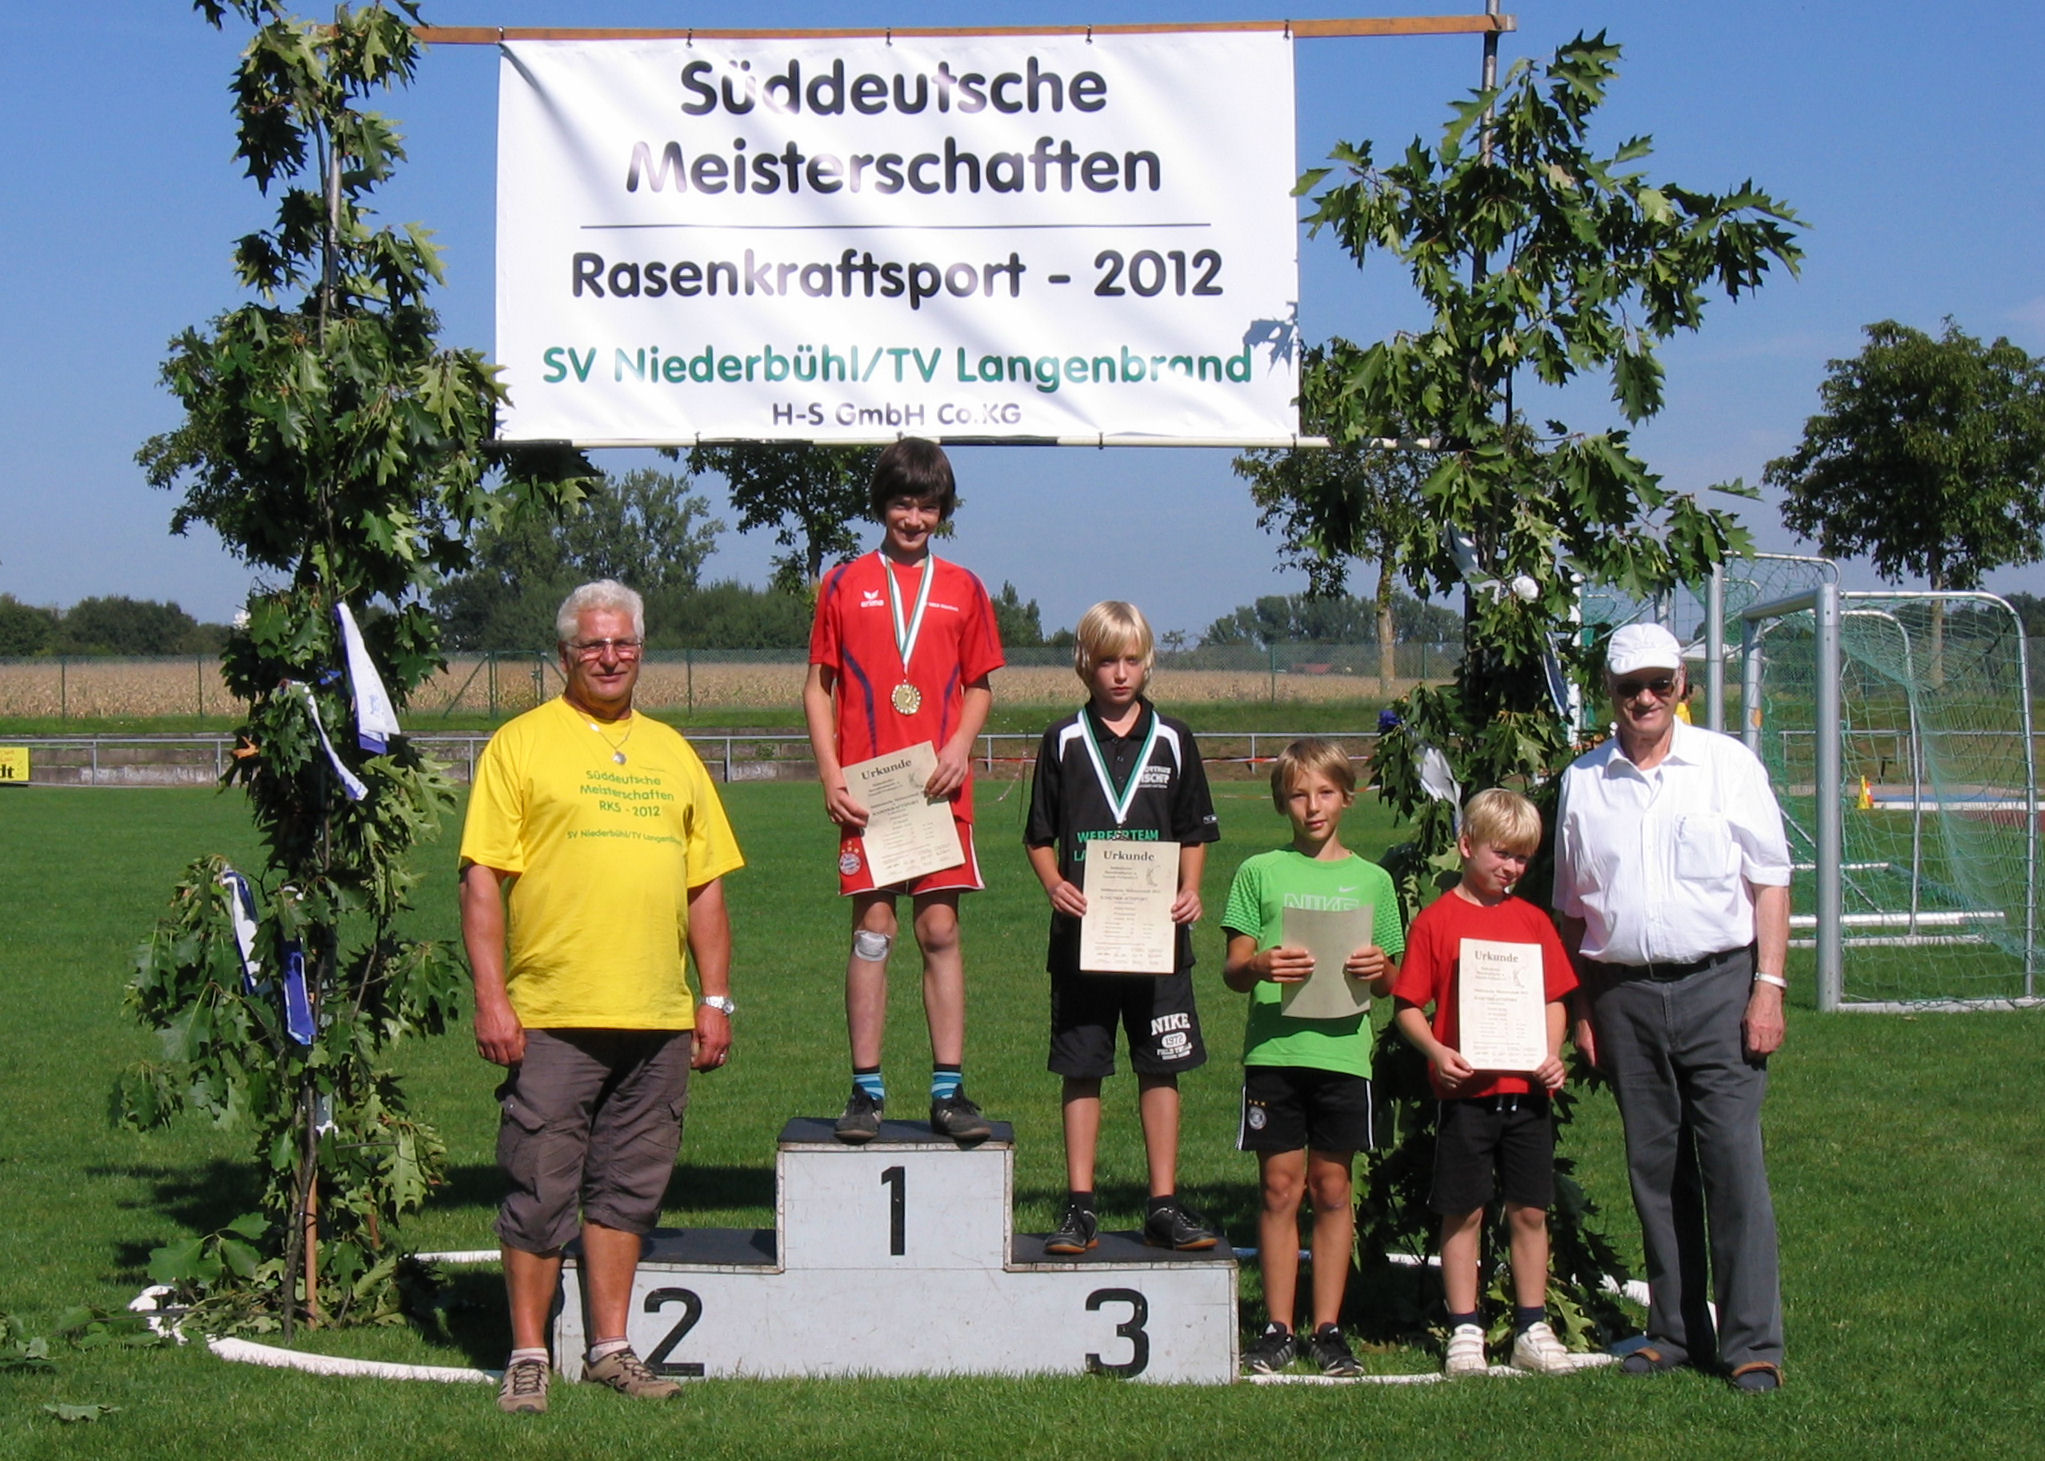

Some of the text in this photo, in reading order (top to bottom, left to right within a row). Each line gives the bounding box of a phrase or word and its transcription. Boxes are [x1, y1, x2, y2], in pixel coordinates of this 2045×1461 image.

[680, 55, 1107, 116] Süddeutsche
[626, 135, 1160, 195] Meisterschaften
[571, 247, 1027, 310] Rasenkraftsport
[1093, 248, 1224, 297] 2012
[543, 344, 1252, 393] SV Niederbühl/TV Langenbrand
[772, 402, 824, 426] H-S
[835, 402, 925, 427] GmbH
[586, 770, 661, 785] Süddeutsche
[861, 759, 912, 780] Urkunde
[580, 785, 674, 801] Meisterschaften
[599, 801, 621, 812] RKS
[633, 805, 660, 817] 2012
[1103, 850, 1155, 862] Urkunde
[1474, 949, 1519, 963] Urkunde
[1151, 1012, 1191, 1036] NIKE
[1165, 1034, 1185, 1046] 1972
[880, 1165, 906, 1256] 1
[643, 1287, 705, 1377] 2
[1085, 1287, 1150, 1379] 3
